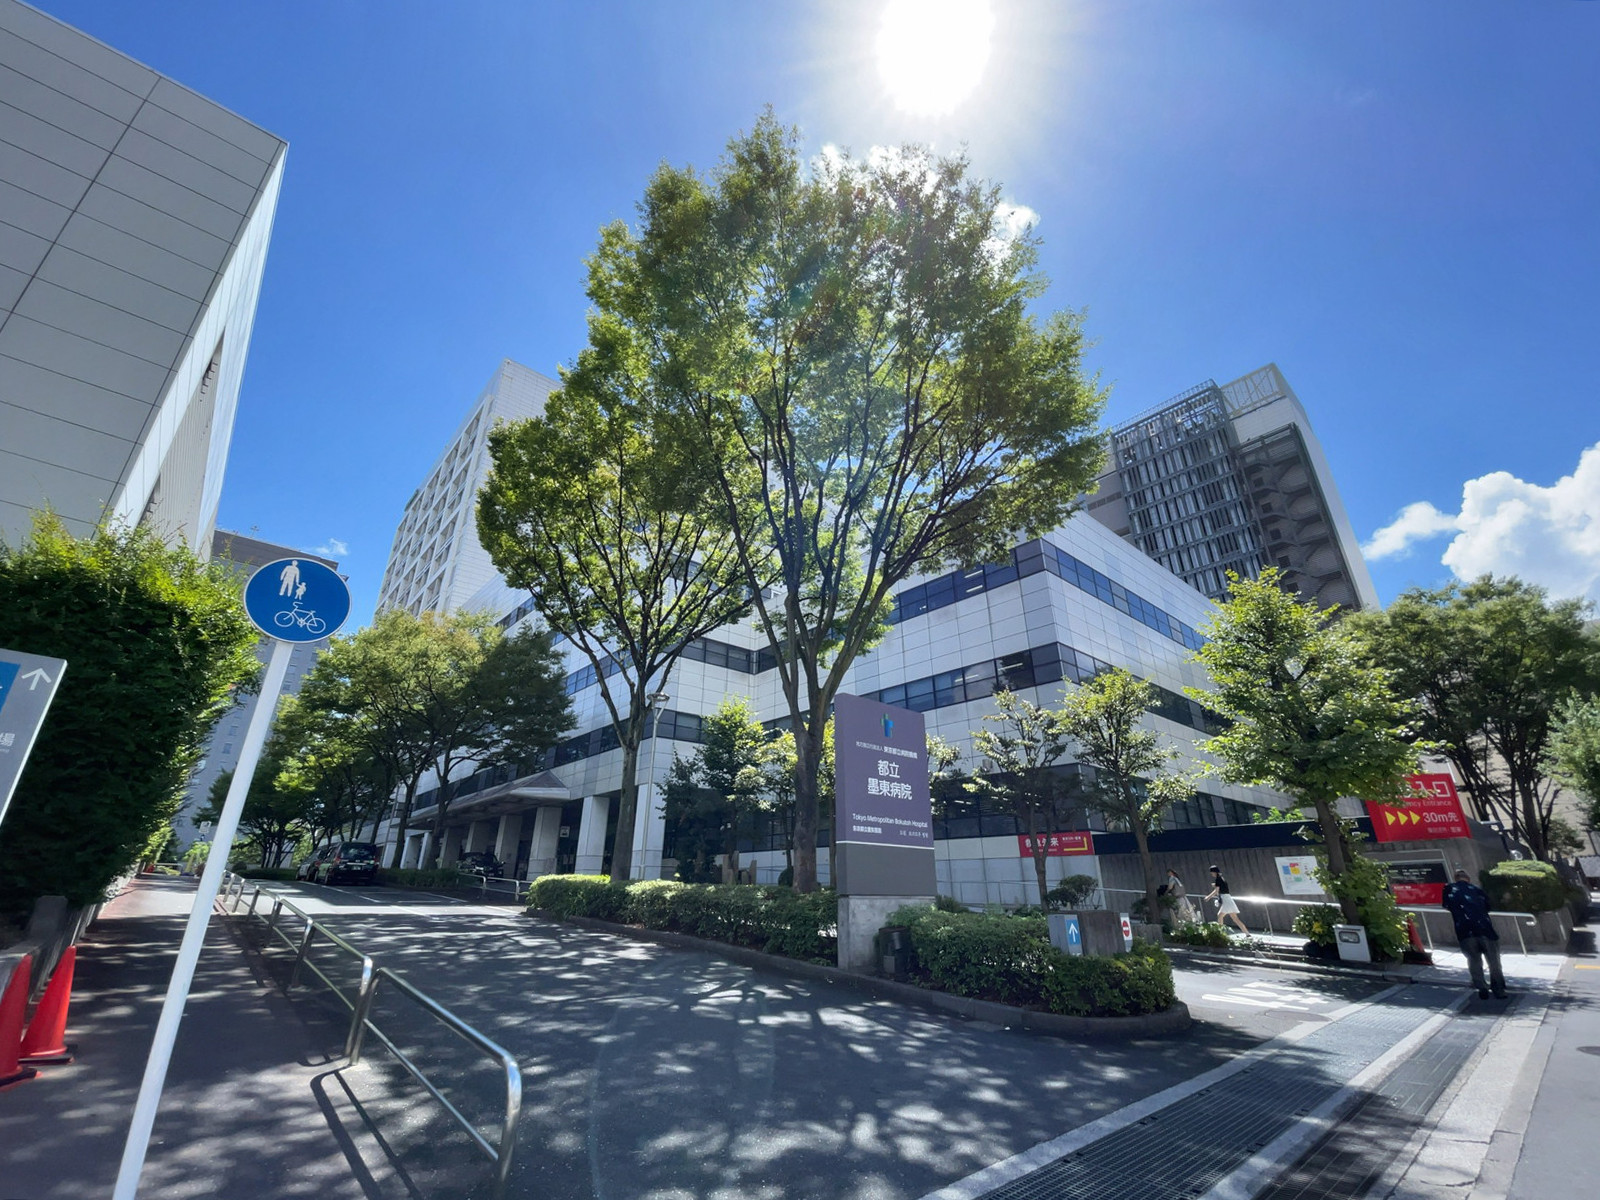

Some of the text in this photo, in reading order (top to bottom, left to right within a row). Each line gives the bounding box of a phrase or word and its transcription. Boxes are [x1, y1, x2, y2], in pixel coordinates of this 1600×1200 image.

[878, 760, 900, 778] 都立
[868, 777, 912, 800] 墨東病院
[852, 813, 928, 828] Tokyo Metropolitan Bokutoh Hospital
[1422, 812, 1460, 823] 30m先
